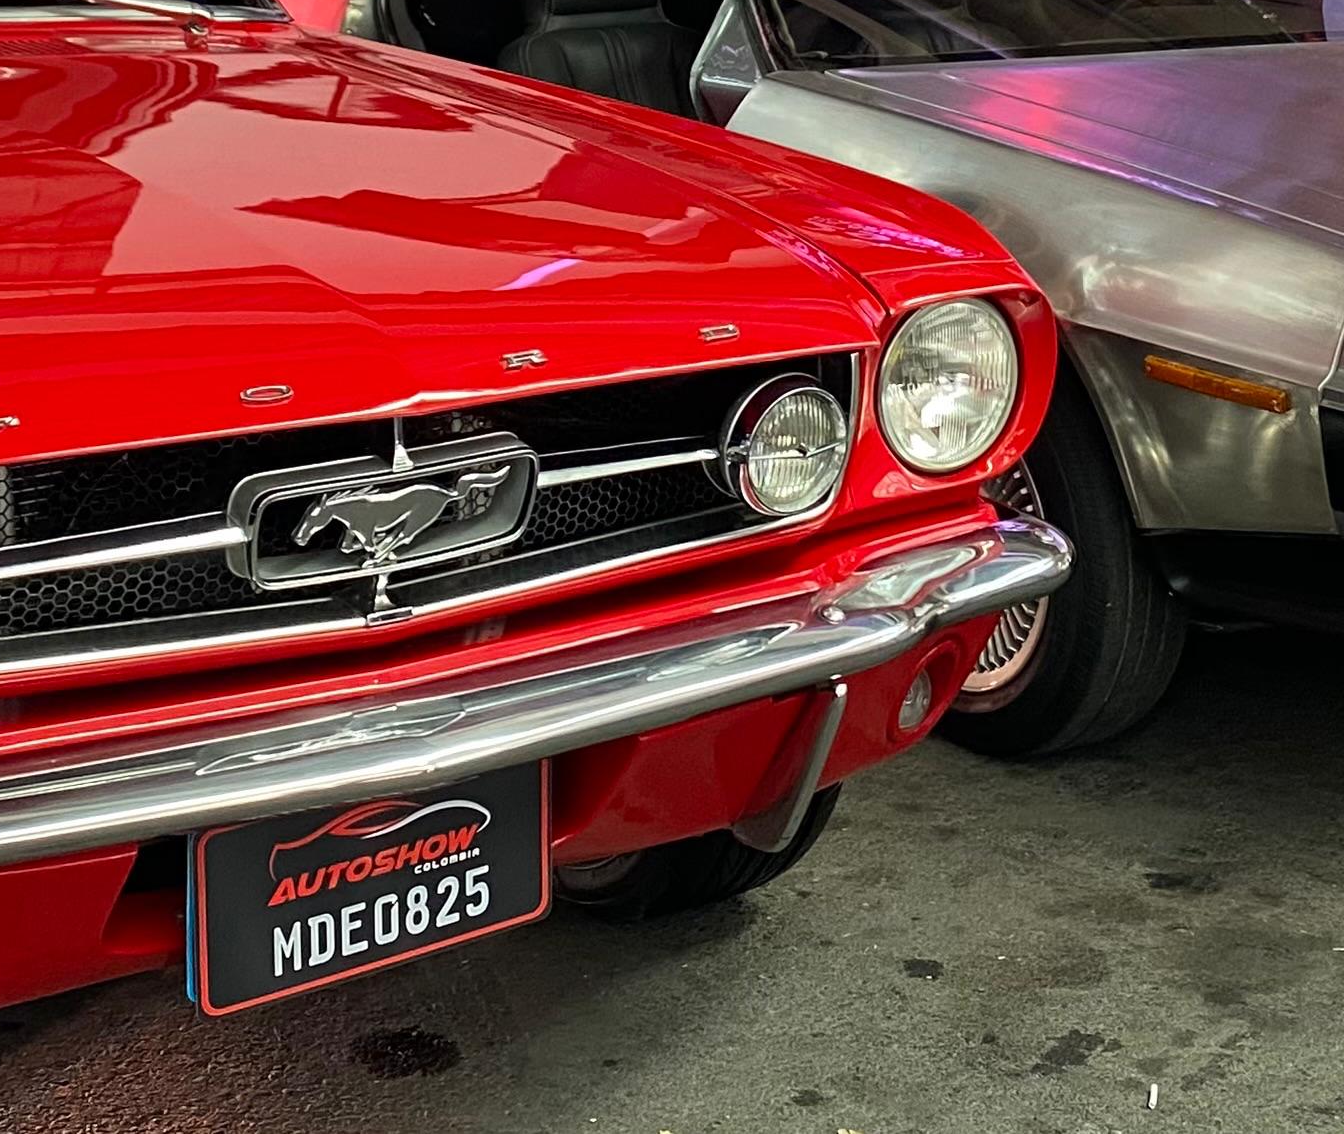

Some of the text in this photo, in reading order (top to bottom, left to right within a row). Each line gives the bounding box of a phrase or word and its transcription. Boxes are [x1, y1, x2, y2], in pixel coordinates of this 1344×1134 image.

[268, 824, 480, 907] AUTOSHOW
[414, 847, 480, 874] COLOMBIA
[273, 865, 490, 977] MDE0825
